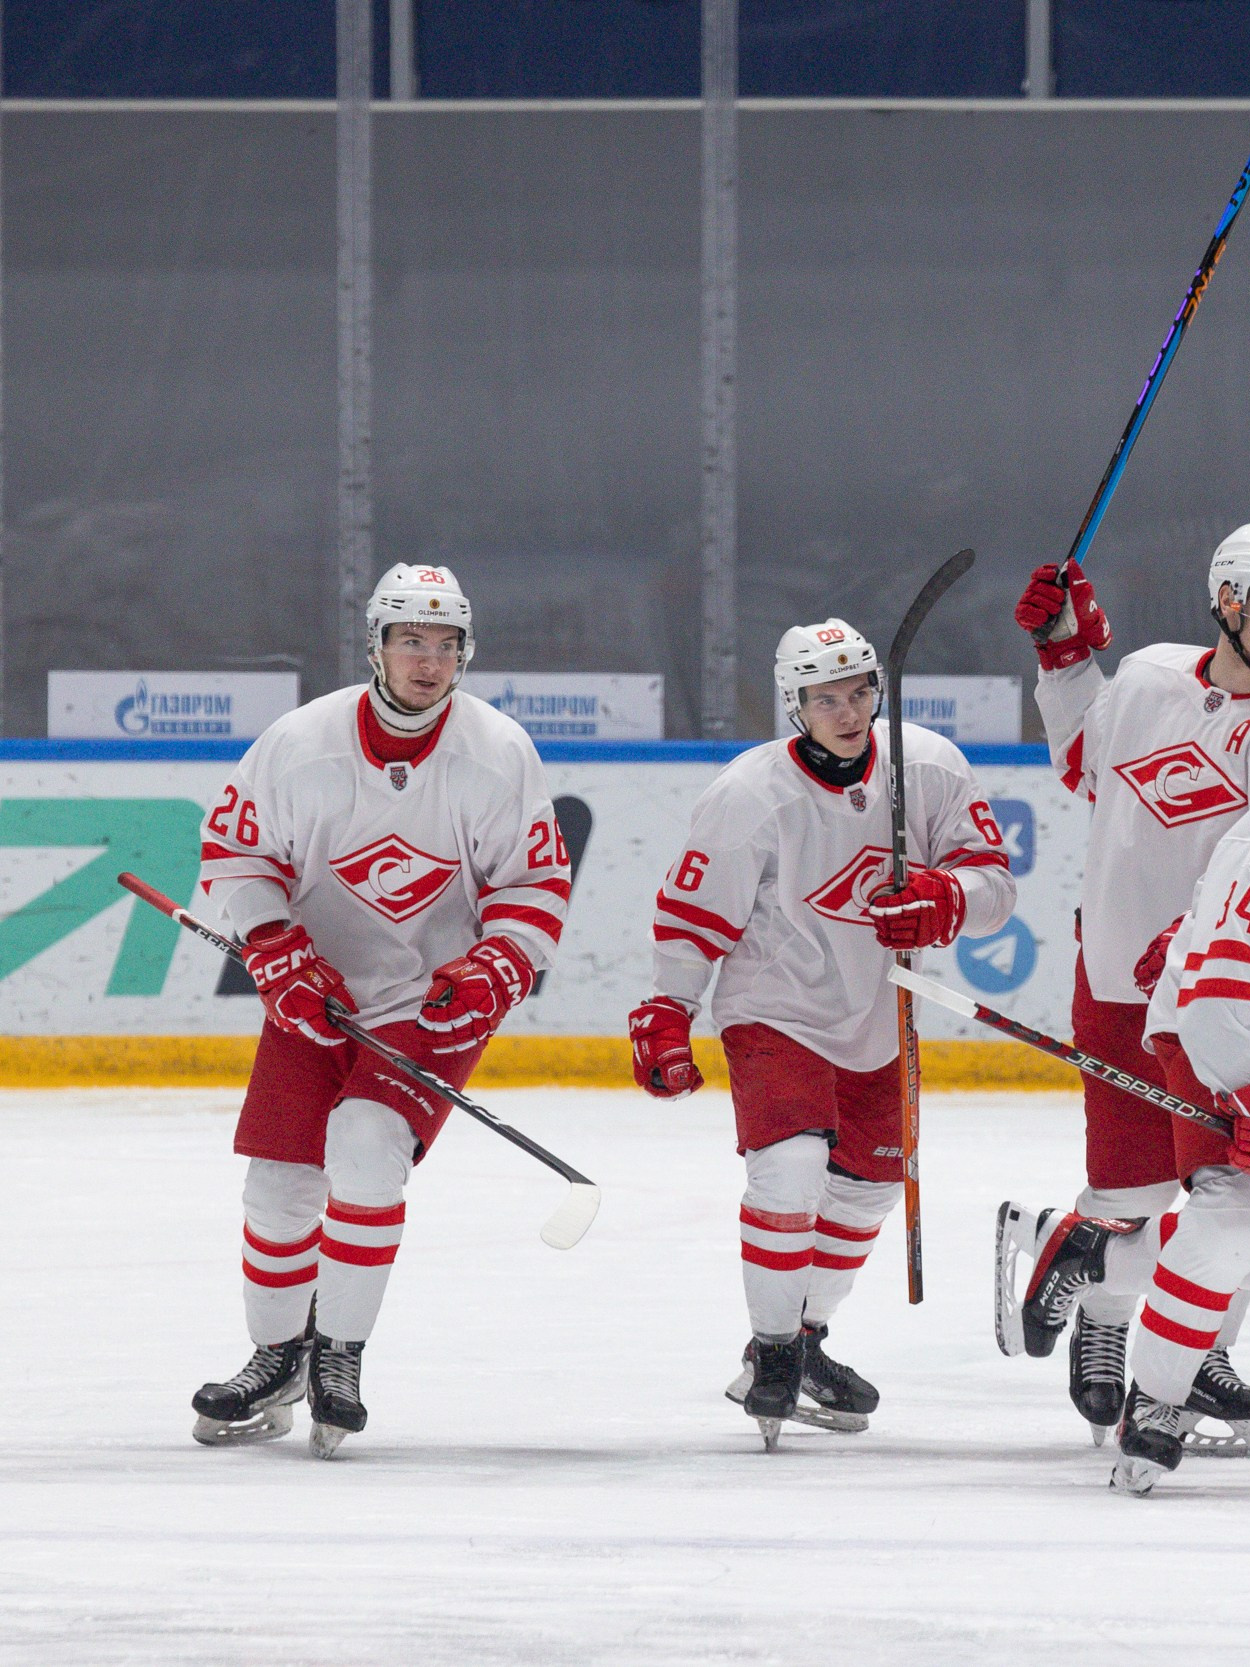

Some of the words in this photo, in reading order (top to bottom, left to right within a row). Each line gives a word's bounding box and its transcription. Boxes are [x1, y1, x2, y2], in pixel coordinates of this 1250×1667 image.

[417, 569, 446, 585] 26
[418, 609, 450, 617] OLIMPBET
[829, 663, 860, 675] OLIMPBET
[151, 692, 232, 715] ГАЗПРОМ
[207, 784, 260, 847] 26
[968, 800, 1003, 847] 6
[196, 928, 231, 953] CCM
[251, 943, 317, 987] CCM
[473, 945, 523, 1007] CCM
[373, 1072, 436, 1117] TRUE
[1066, 1052, 1198, 1117] JETSPEED
[1040, 1270, 1061, 1307] CCM
